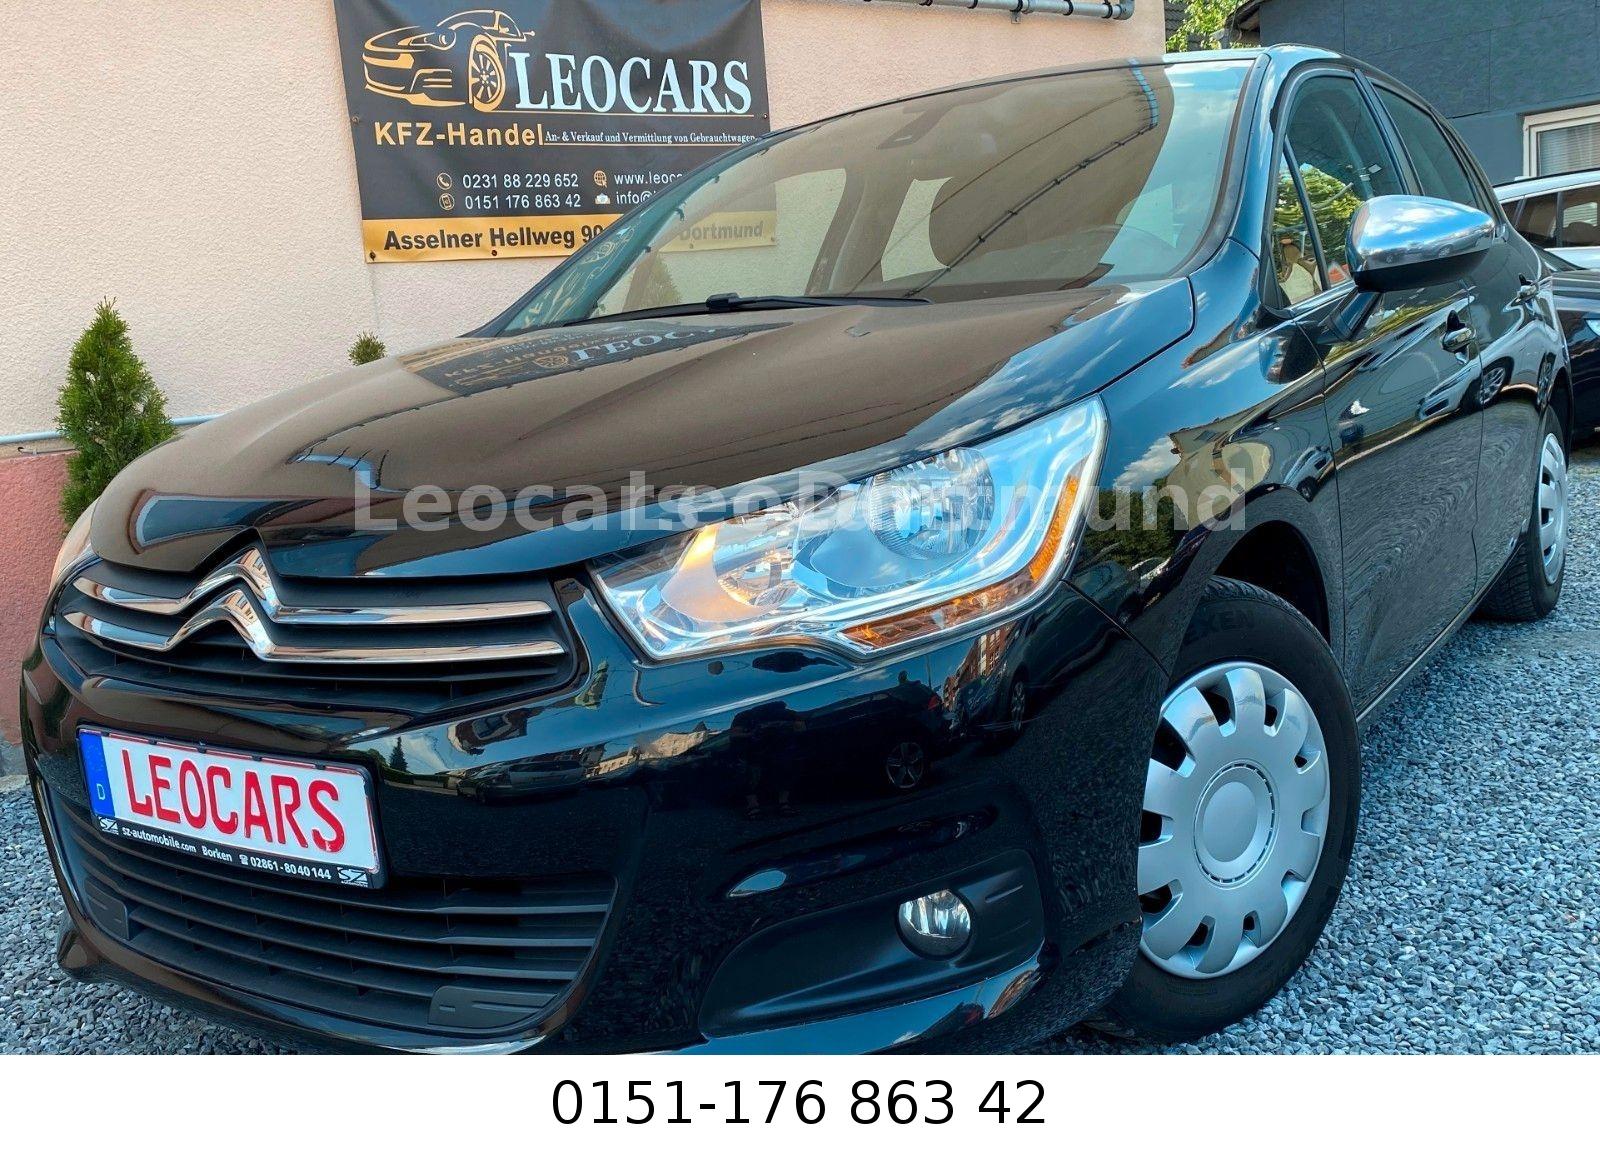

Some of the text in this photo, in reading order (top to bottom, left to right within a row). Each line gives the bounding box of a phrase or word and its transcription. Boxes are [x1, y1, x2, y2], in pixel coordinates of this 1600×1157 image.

[509, 51, 752, 114] LEOCARS
[374, 122, 544, 146] KFZ-Handel
[570, 131, 603, 142] Verkauf
[605, 131, 620, 142] und
[622, 131, 672, 144] Vermittlung
[674, 134, 688, 143] von
[463, 172, 580, 189] 0231 88 229 652
[465, 193, 582, 210] 0151 176 863 42
[616, 190, 656, 204] info@
[384, 230, 483, 250] Asselner
[489, 227, 575, 249] Hellweg
[97, 749, 345, 852] D LEOCARS
[121, 827, 197, 853] sz-automobile.com
[202, 845, 233, 862] Borken
